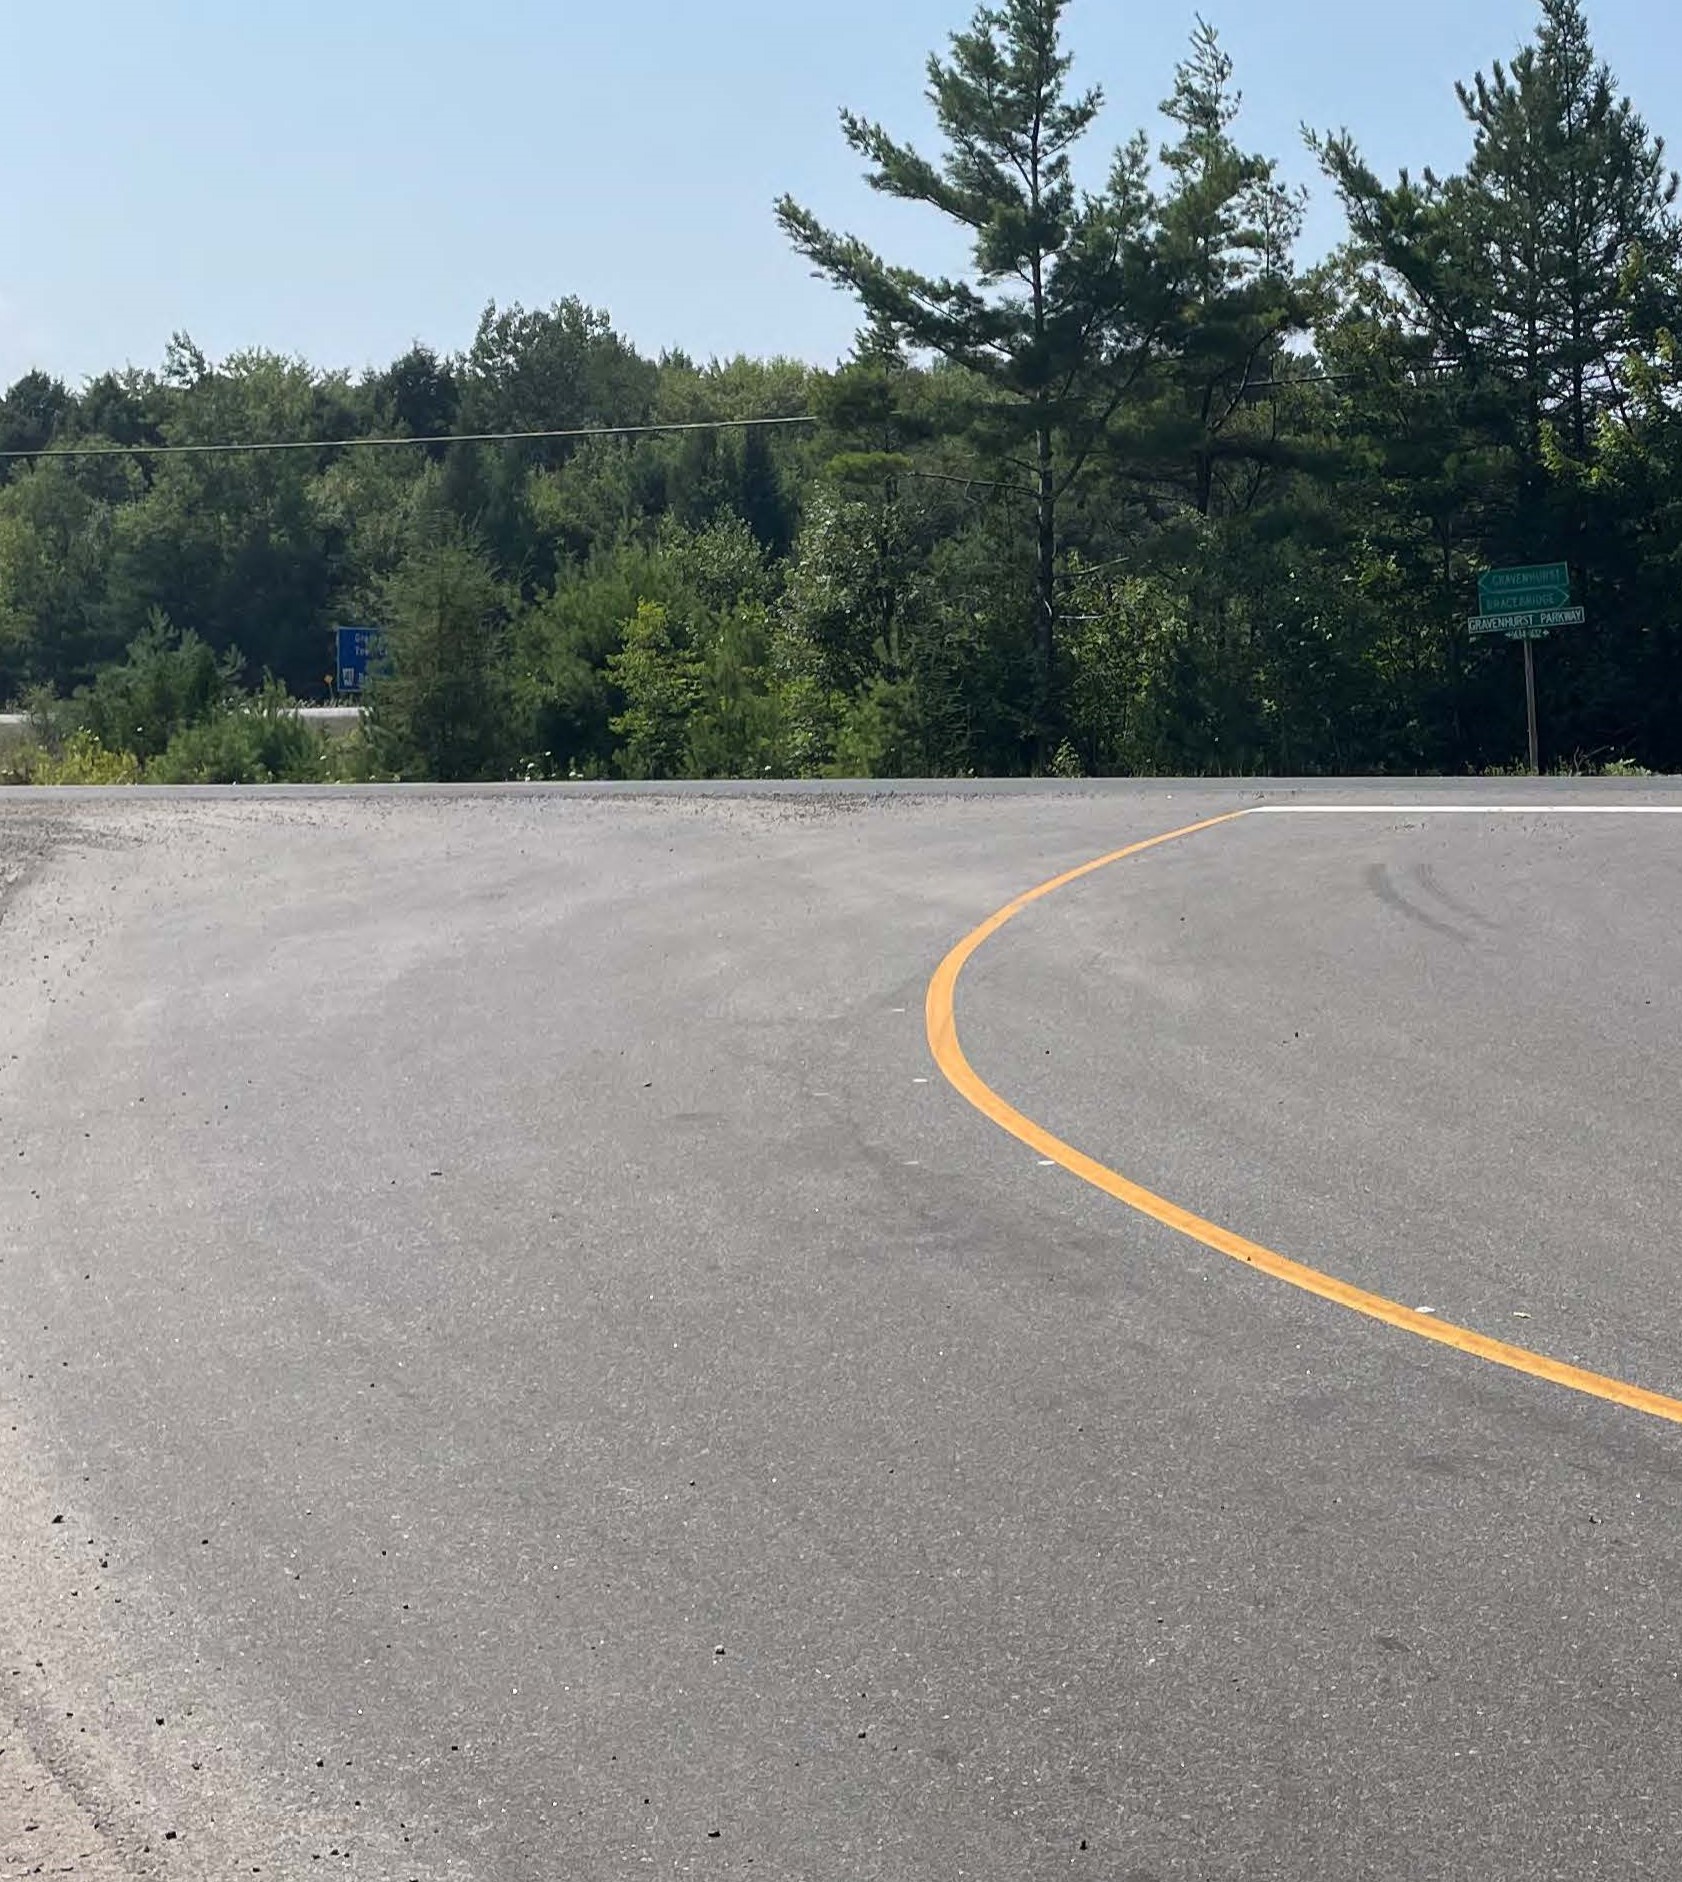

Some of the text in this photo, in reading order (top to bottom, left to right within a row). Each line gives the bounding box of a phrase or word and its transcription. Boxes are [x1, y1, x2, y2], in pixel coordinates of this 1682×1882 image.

[1491, 568, 1559, 585] GRAVENHURST
[1486, 593, 1554, 609] BRACEBRIDGE
[1469, 610, 1581, 630] GRAVENHURST PARKWAY
